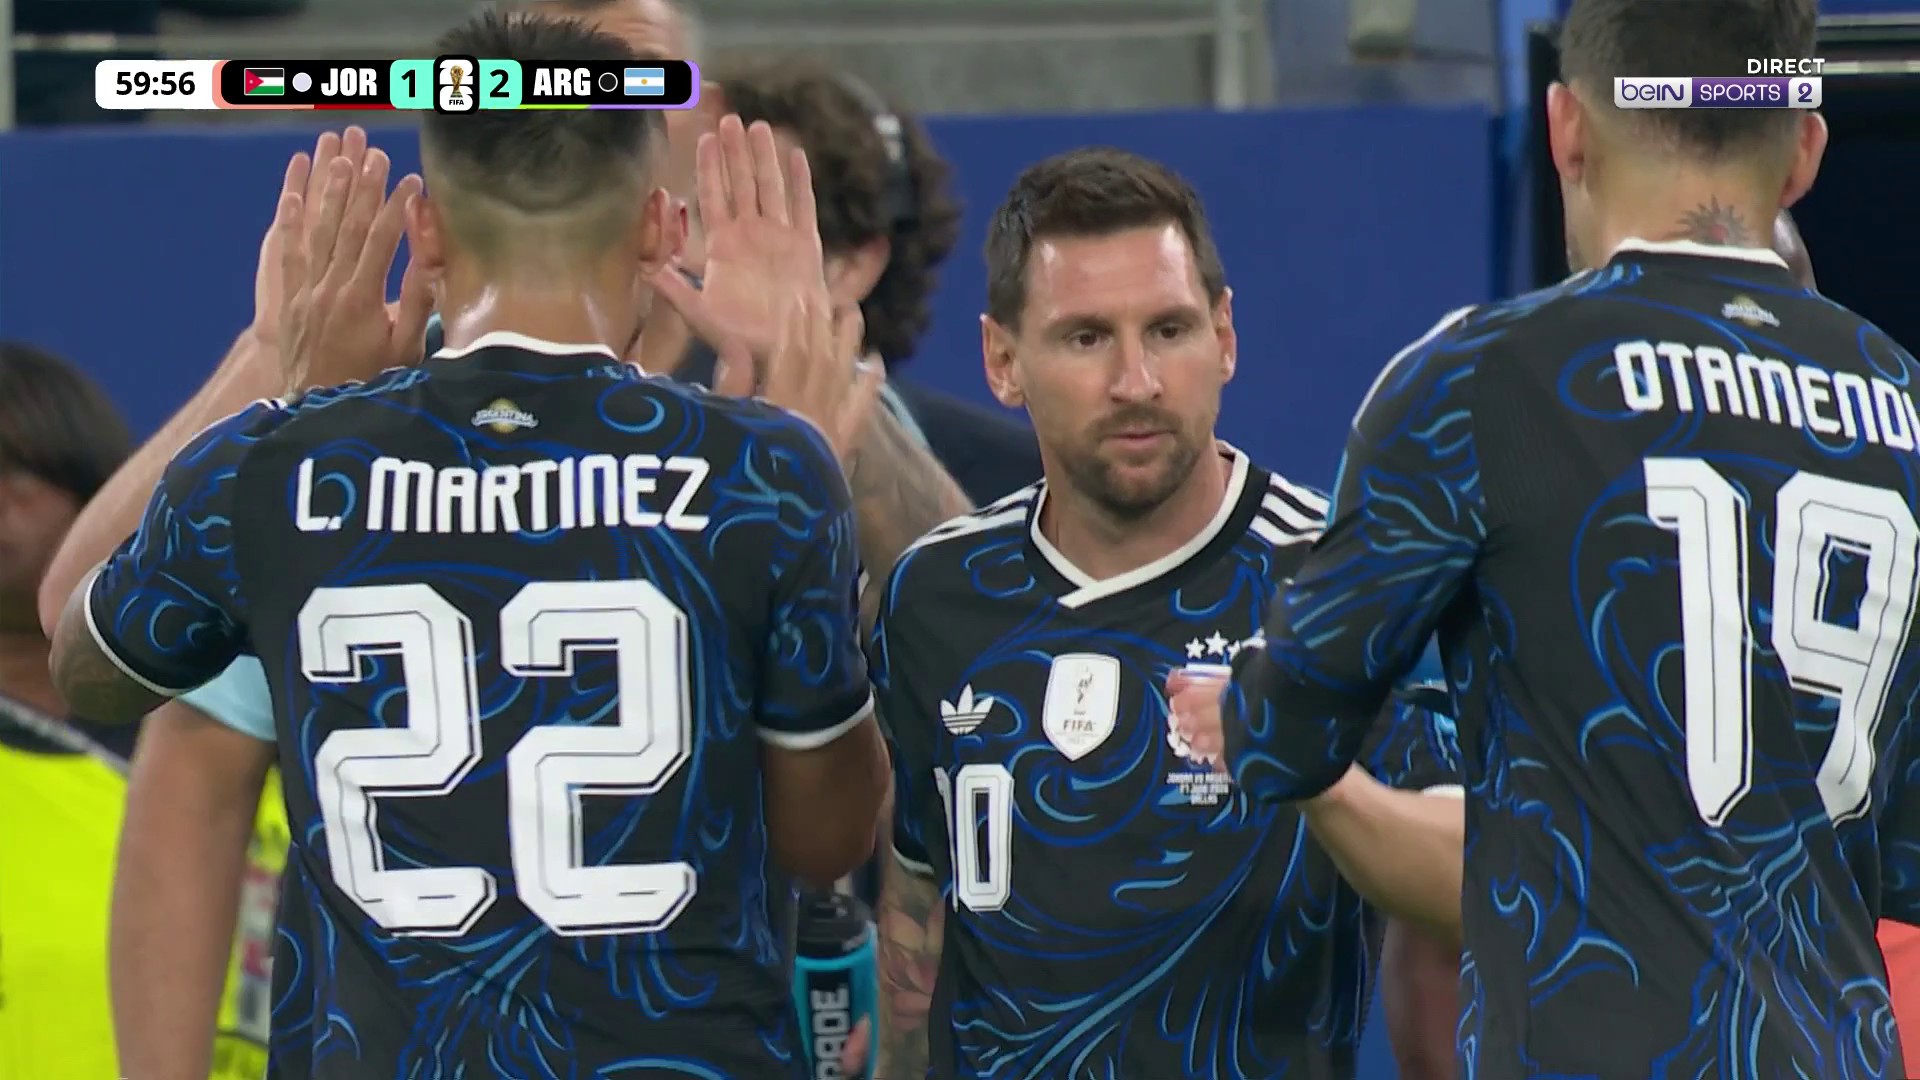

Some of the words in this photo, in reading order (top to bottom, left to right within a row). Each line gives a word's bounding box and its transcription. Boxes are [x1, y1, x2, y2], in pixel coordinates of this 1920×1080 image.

[296, 458, 342, 531] L.
[366, 454, 711, 533] MARTINEZ
[1643, 457, 1920, 829] 19
[298, 579, 698, 938] 22
[1063, 719, 1093, 732] FIFA
[934, 763, 1015, 912] 10
